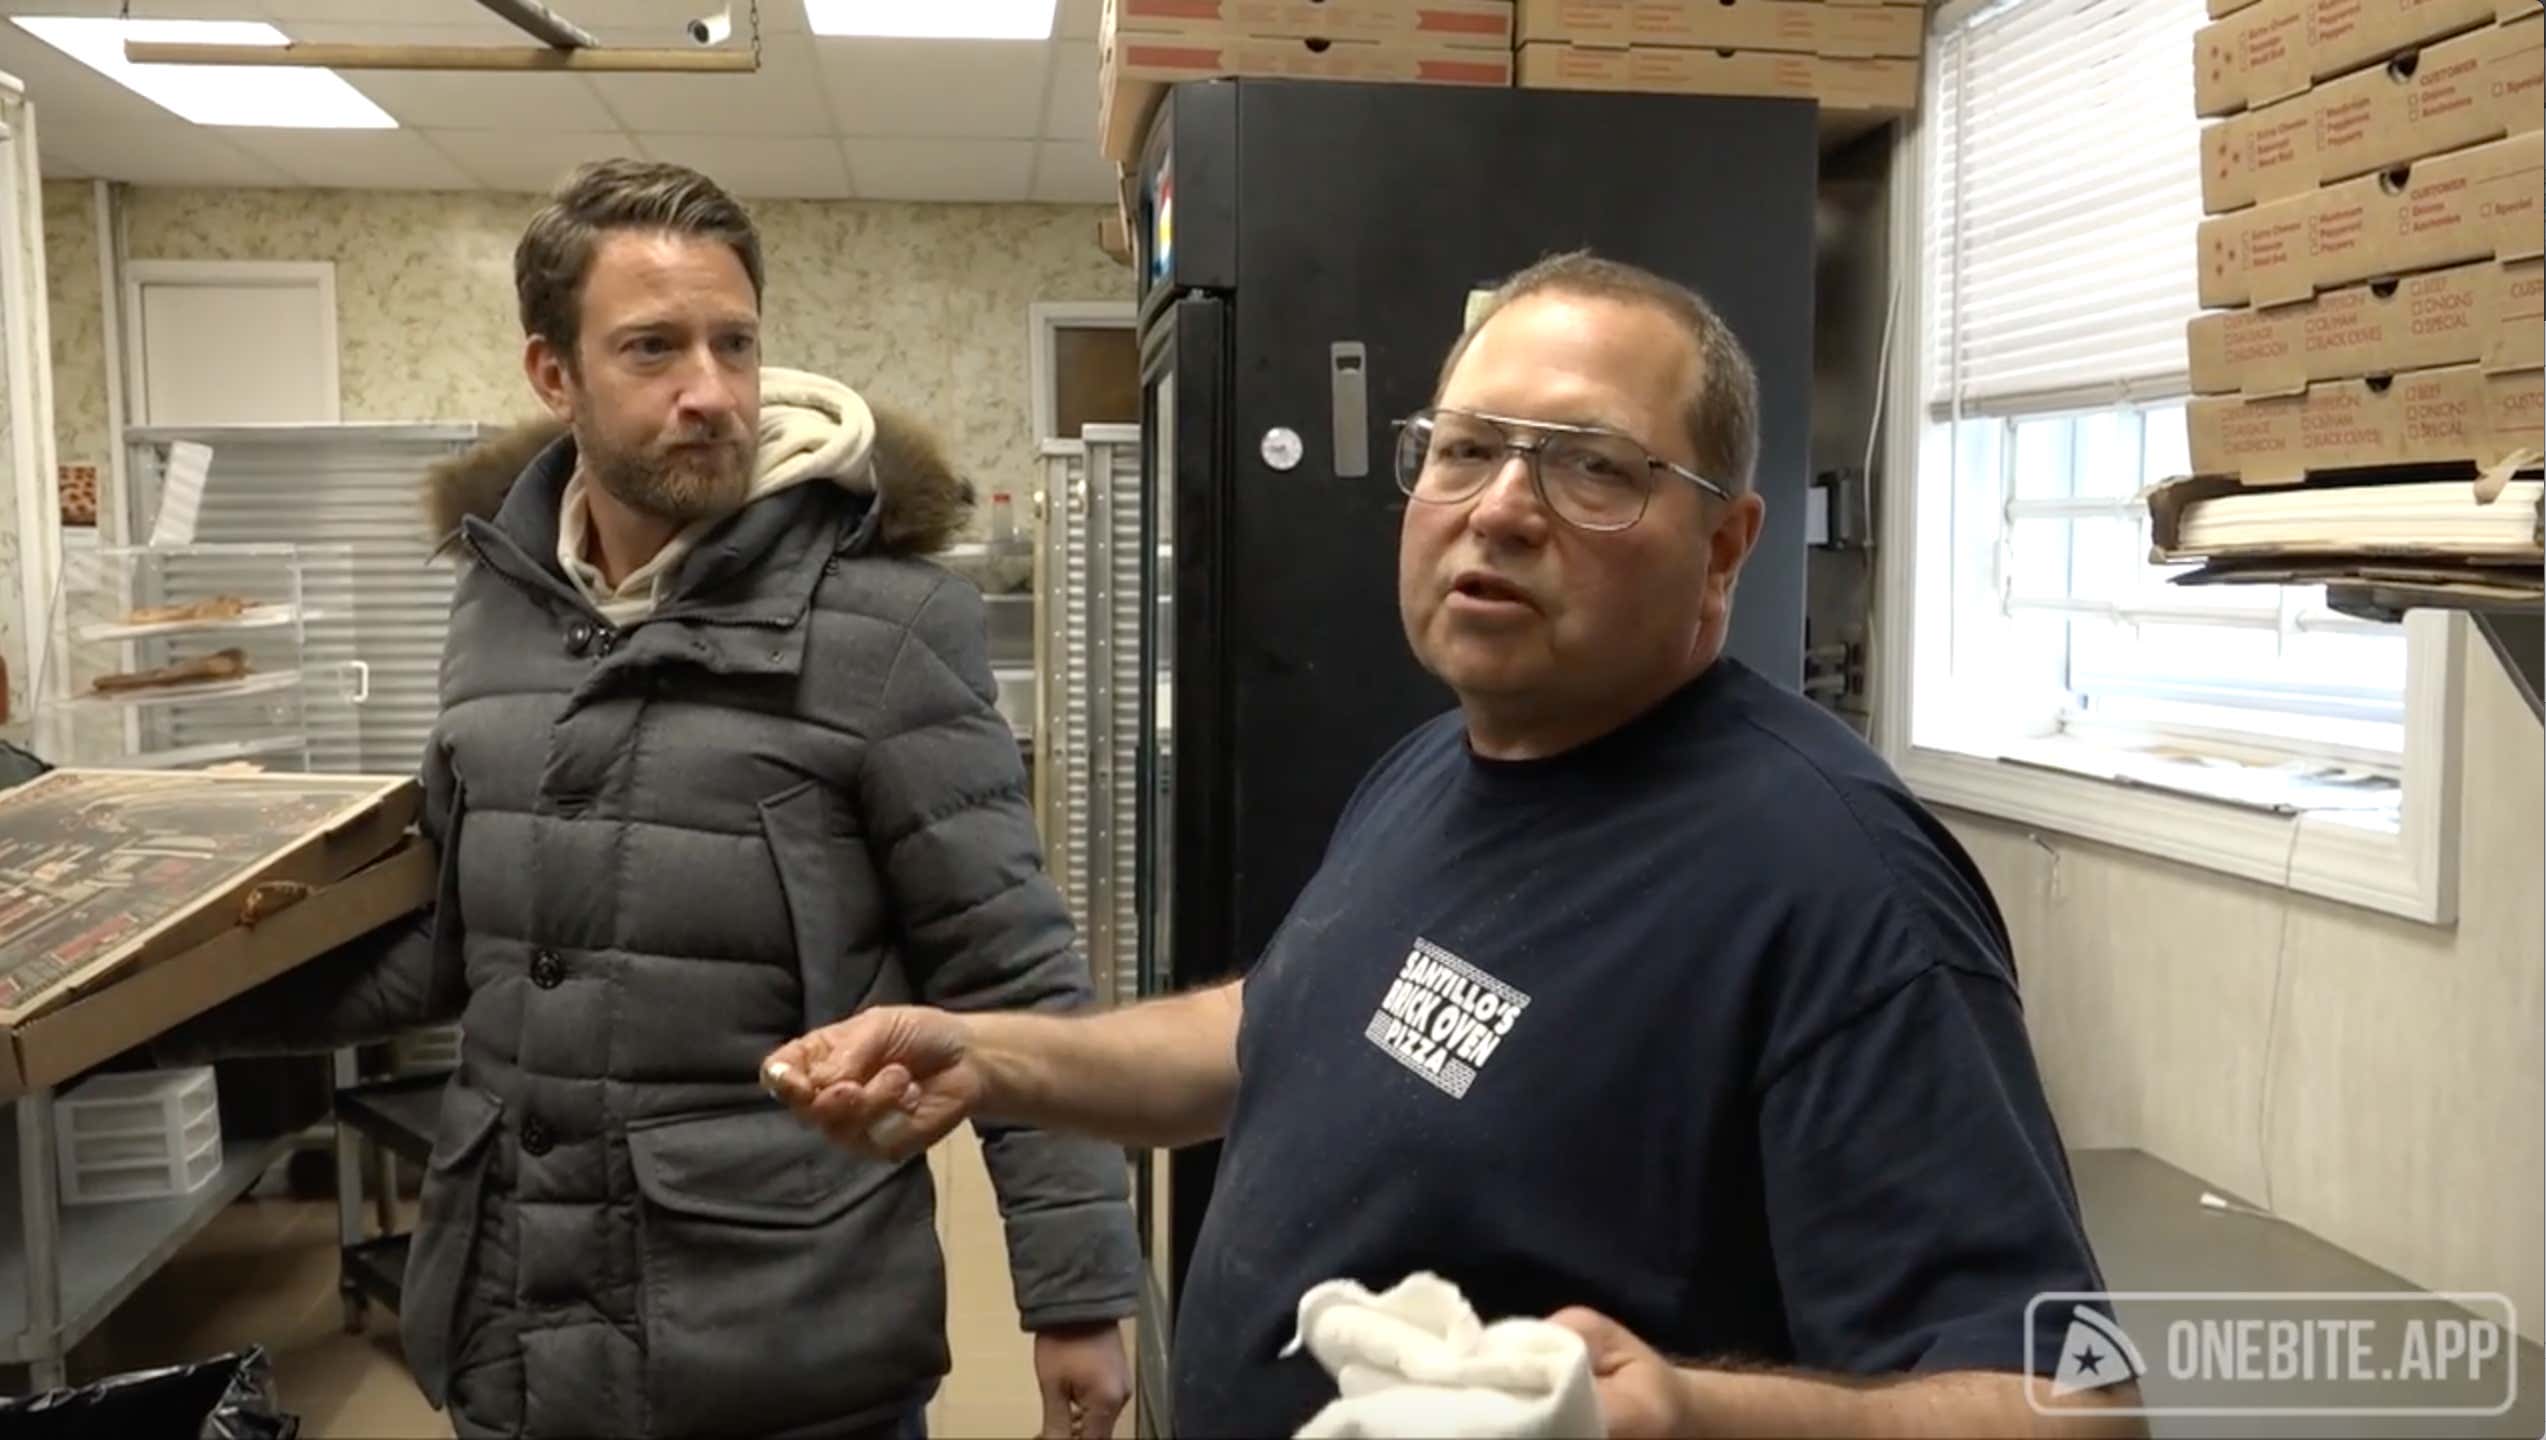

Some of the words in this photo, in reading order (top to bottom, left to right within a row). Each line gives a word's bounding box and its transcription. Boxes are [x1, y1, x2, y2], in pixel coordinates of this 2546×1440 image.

[1400, 951, 1521, 1035] SANTILLO'S
[1385, 1018, 1448, 1074] PIZZA
[1431, 1005, 1501, 1067] OVEN
